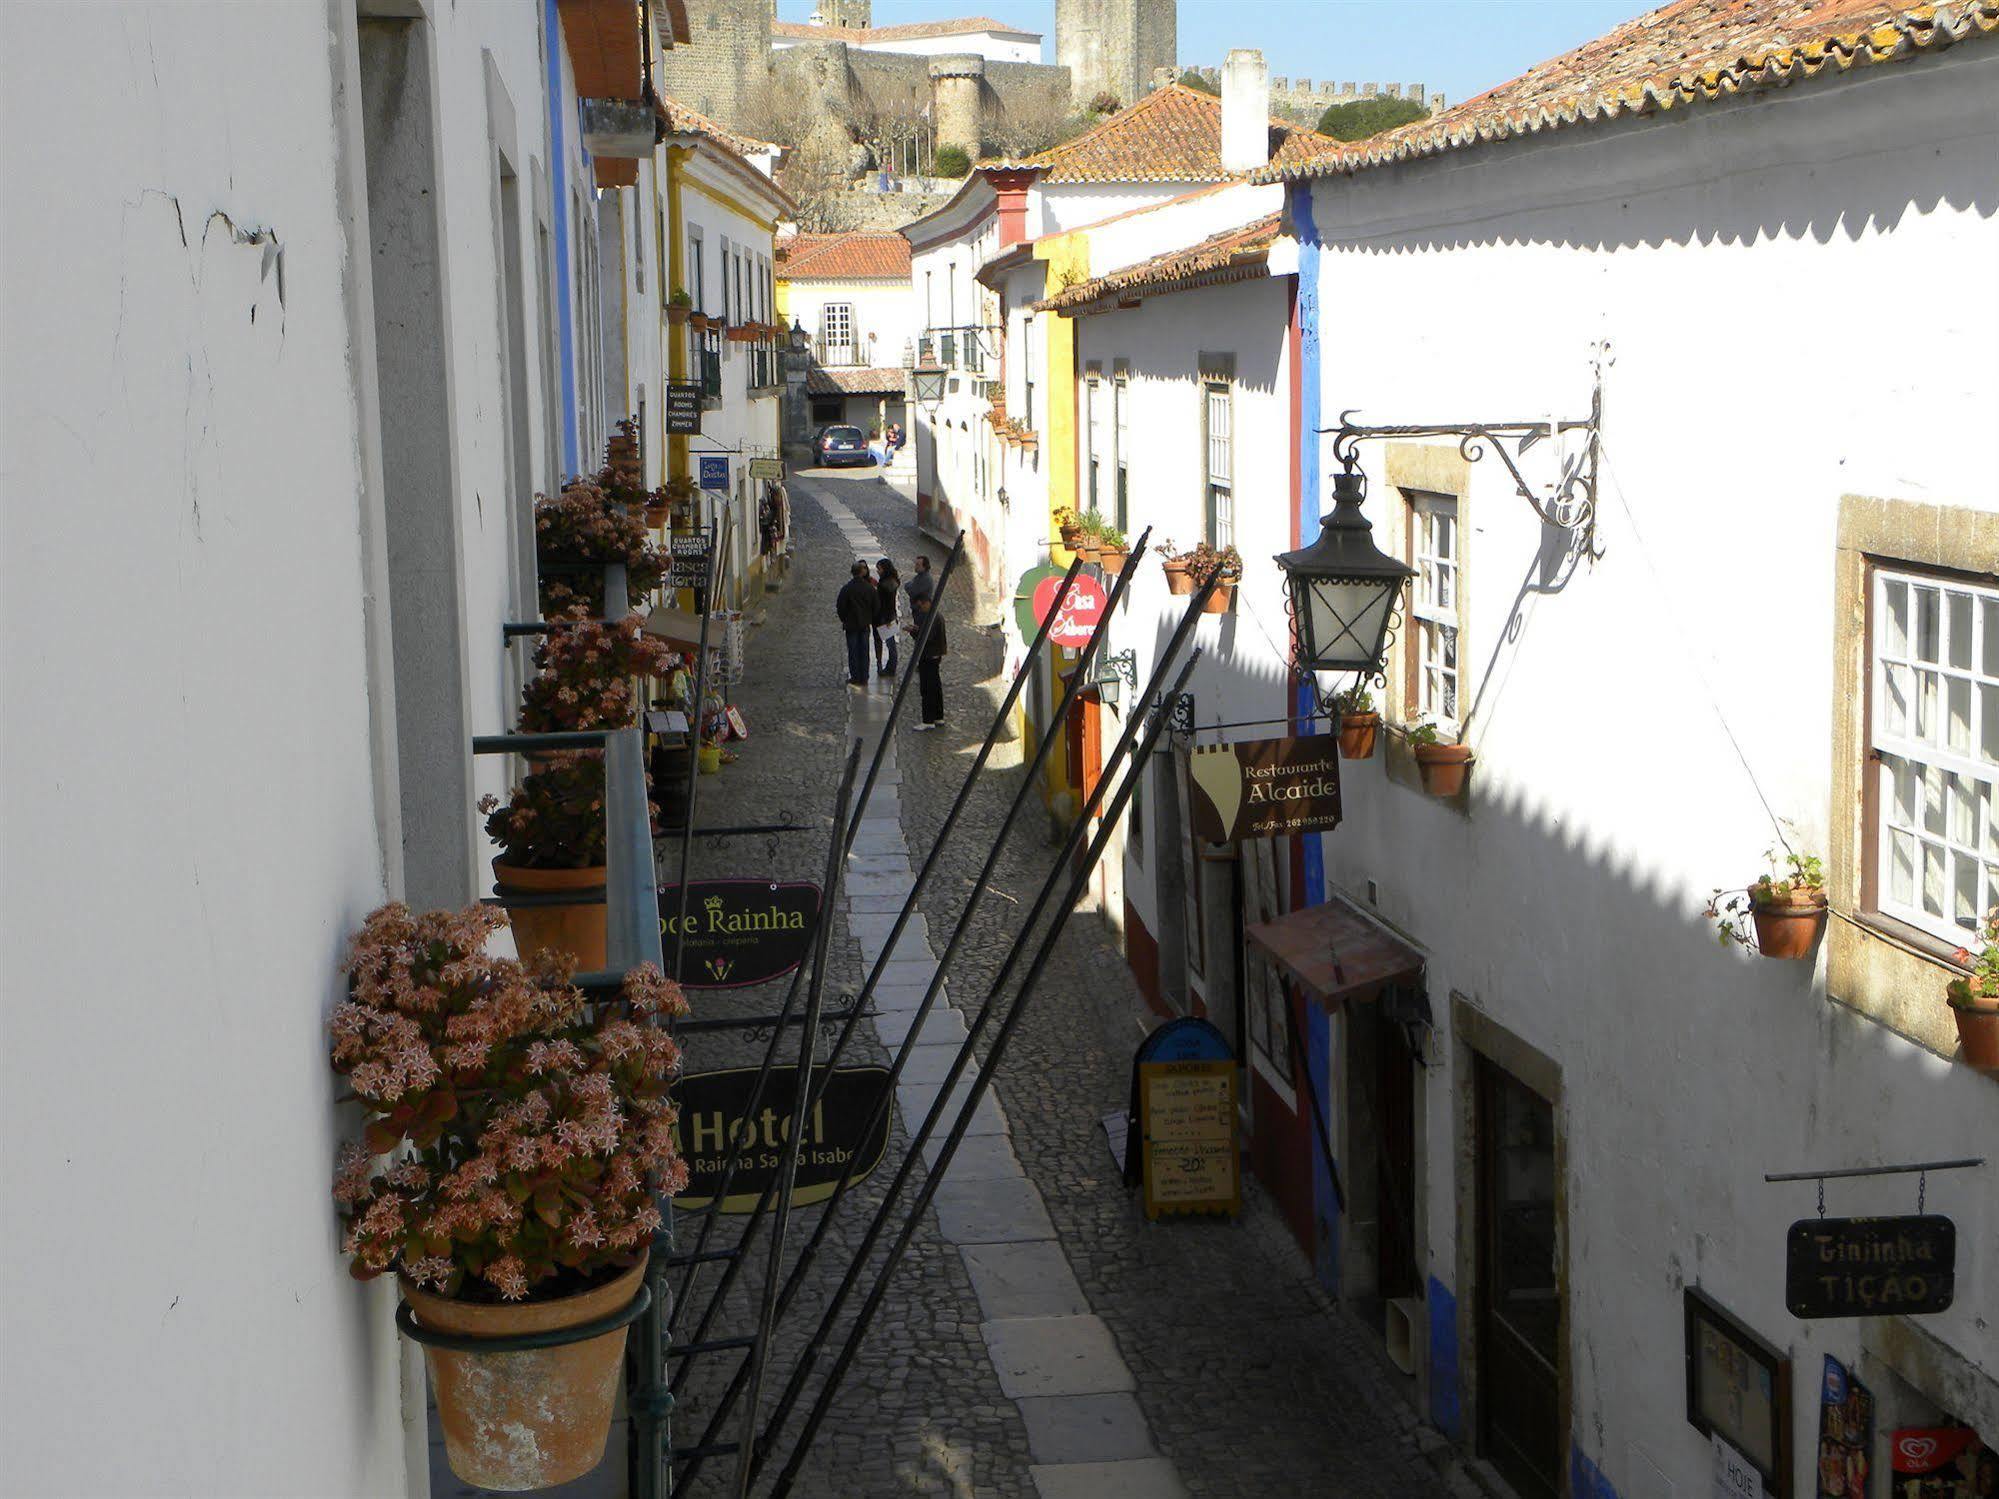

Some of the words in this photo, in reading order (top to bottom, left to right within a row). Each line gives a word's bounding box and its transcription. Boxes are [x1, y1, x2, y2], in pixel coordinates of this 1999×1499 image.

[1244, 758, 1335, 779] Restaurante
[1247, 777, 1337, 804] Alcaide
[707, 905, 805, 935] Rainha
[759, 1152, 807, 1170] Saa
